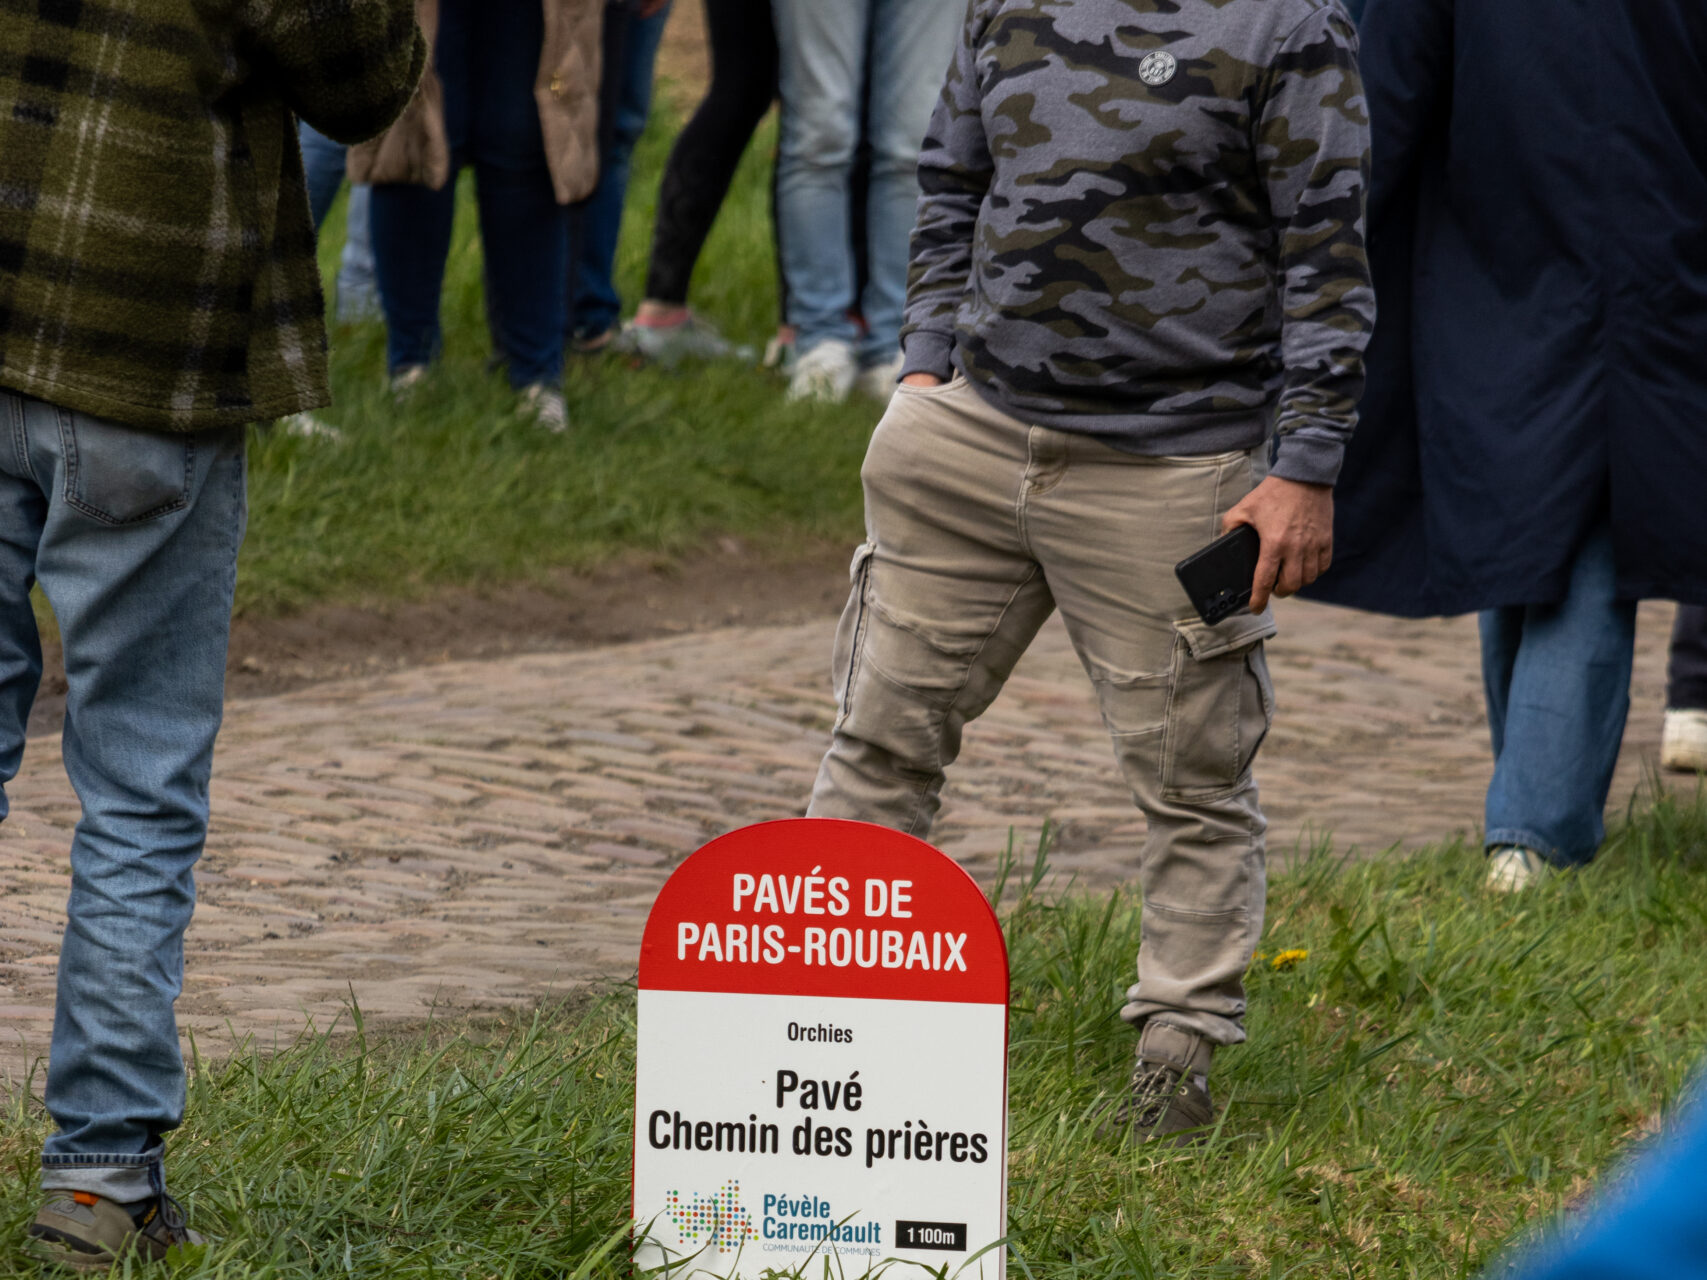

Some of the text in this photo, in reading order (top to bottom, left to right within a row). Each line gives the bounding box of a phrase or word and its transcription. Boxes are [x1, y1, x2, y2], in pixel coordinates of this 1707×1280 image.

[733, 865, 913, 919] PAVÉS DE
[677, 922, 968, 972] PARIS-ROUBAIX
[787, 1021, 853, 1044] Orchies
[776, 1069, 863, 1112] Pavé
[648, 1110, 988, 1168] Chemin des prières
[763, 1193, 831, 1219] Pévèle
[763, 1216, 881, 1244] Carembault
